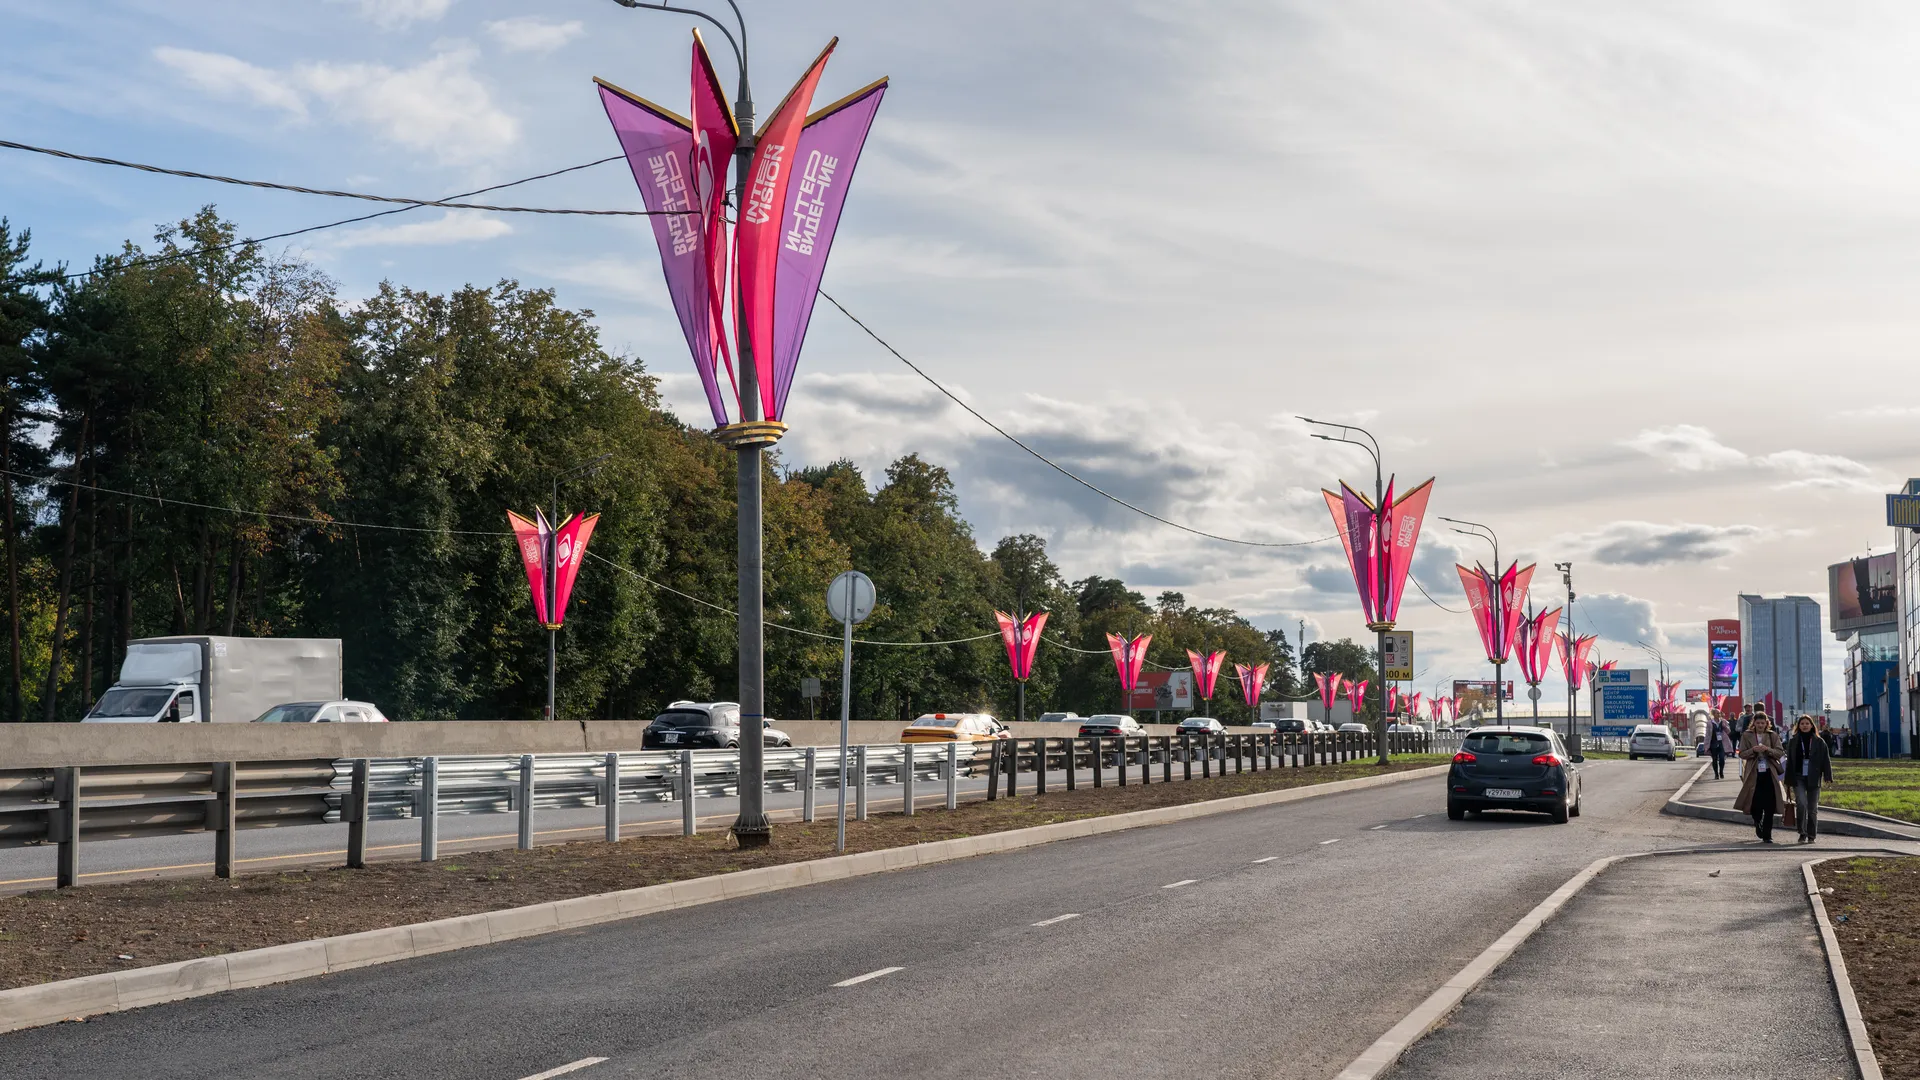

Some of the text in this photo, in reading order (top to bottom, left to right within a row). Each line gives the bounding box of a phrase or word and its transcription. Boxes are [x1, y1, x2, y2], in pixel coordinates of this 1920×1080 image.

[745, 143, 776, 222] INTER
[756, 145, 785, 224] VISION
[785, 150, 821, 252] ИНТЕР
[799, 154, 838, 256] ВИДЕНИЕ
[570, 540, 583, 565] VISION
[1397, 515, 1410, 546] INTER
[1402, 516, 1416, 548] VISION
